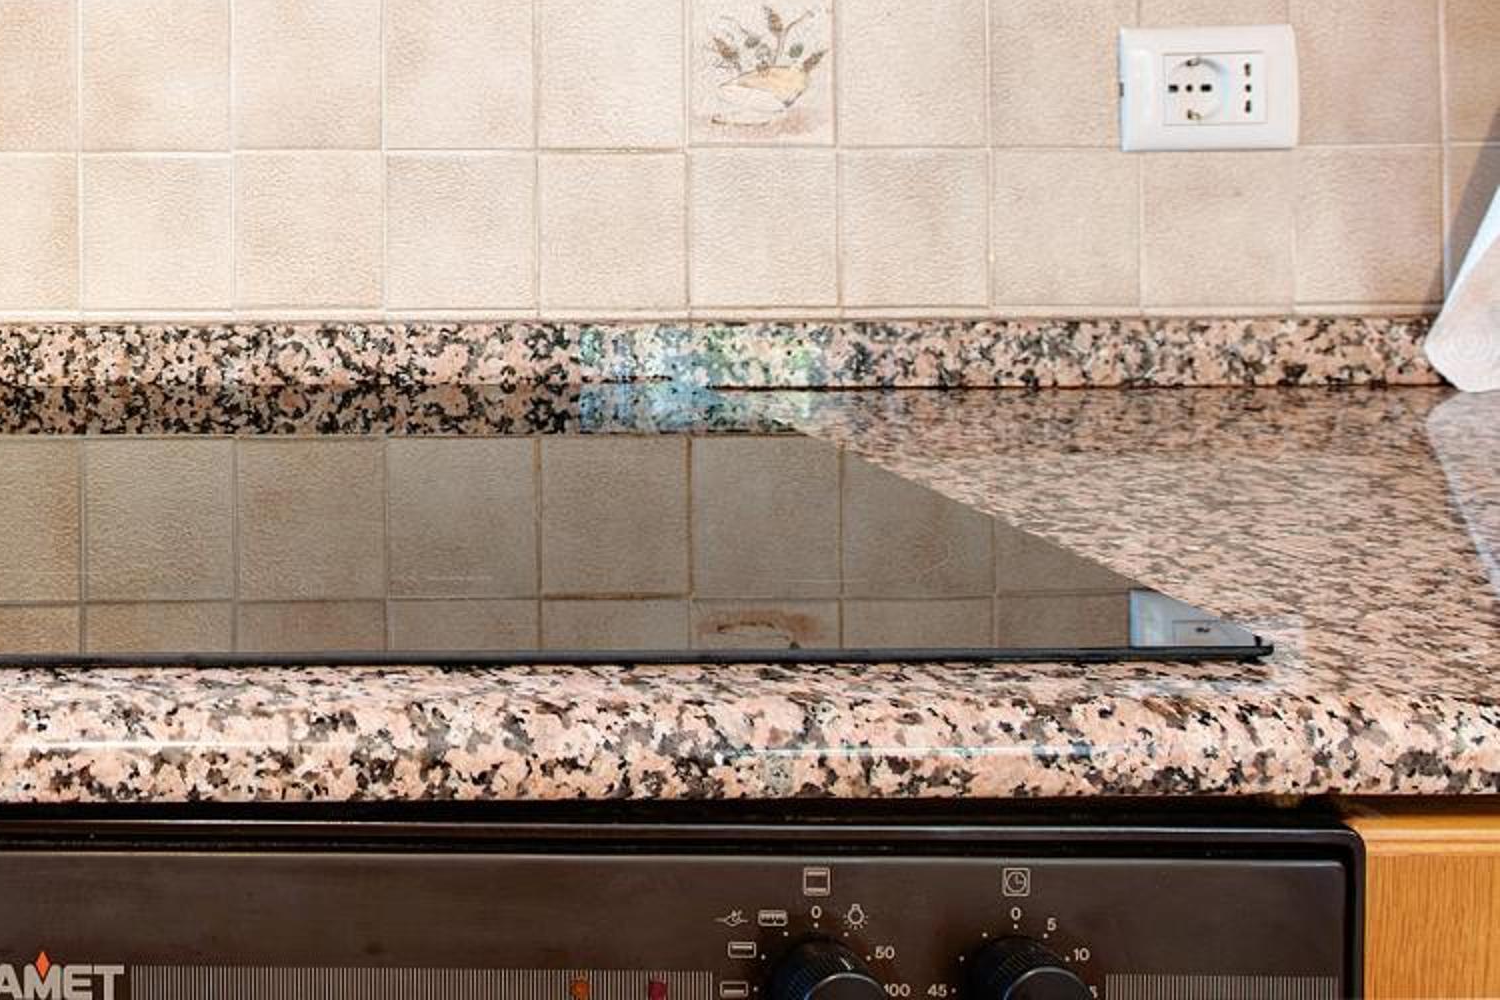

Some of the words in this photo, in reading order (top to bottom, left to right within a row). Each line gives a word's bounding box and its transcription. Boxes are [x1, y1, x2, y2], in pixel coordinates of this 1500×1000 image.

[810, 905, 822, 919] 0
[1010, 906, 1022, 920] 0
[1046, 917, 1057, 932] 5
[875, 945, 895, 960] 50
[1073, 947, 1090, 962] 10
[927, 983, 948, 998] 45
